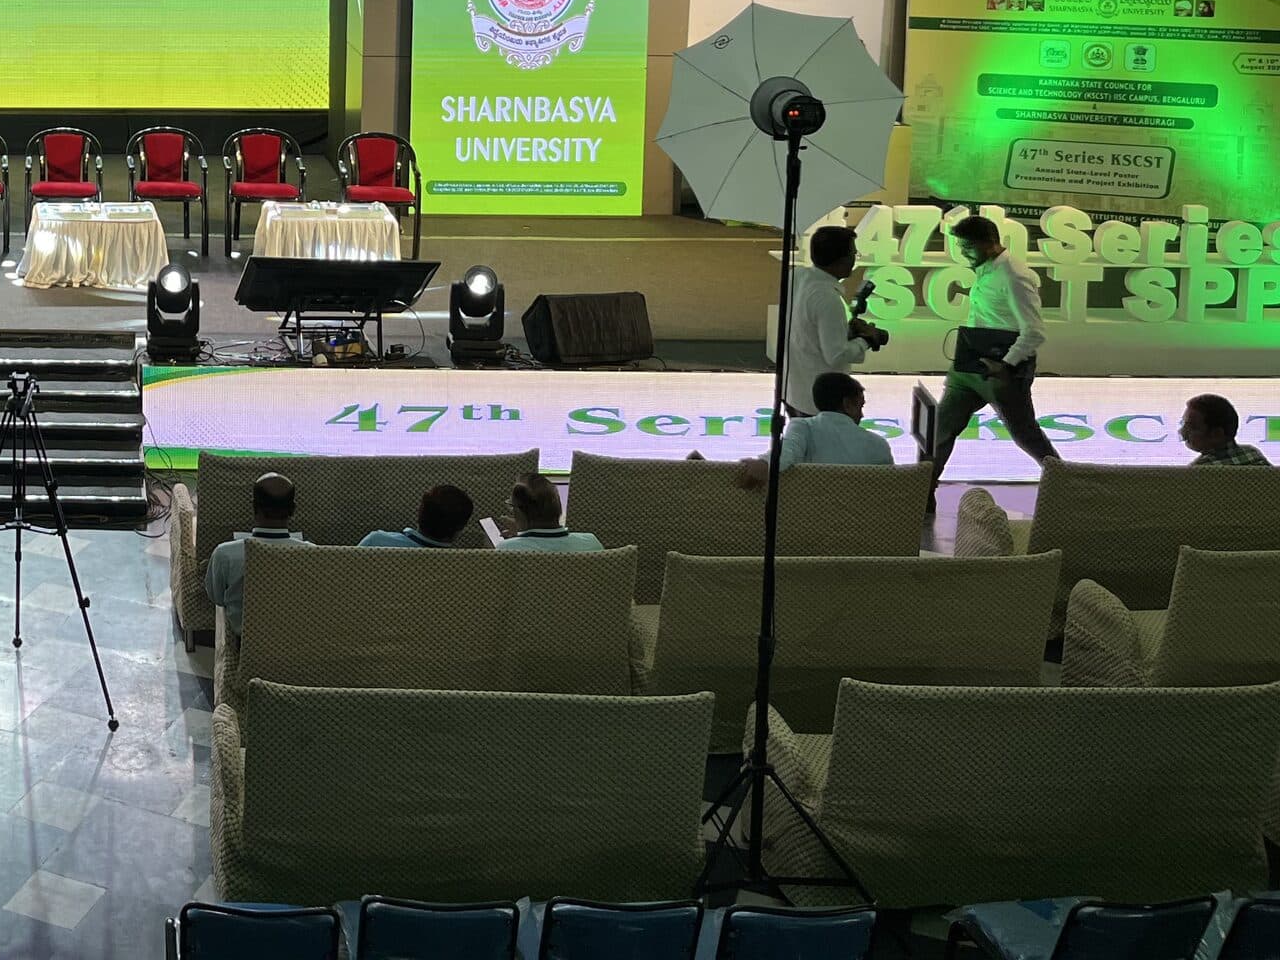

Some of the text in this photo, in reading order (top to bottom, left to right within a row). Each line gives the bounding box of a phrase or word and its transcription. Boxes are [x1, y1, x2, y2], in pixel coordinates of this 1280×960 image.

[1038, 78, 1152, 92] KARNATAKA STATE COUNCIL FOR
[988, 86, 1017, 96] SCIENCE
[1018, 87, 1033, 96] AND
[1034, 88, 1083, 99] TECHNOLOGY
[1162, 96, 1206, 105] BENGALURU
[440, 95, 617, 123] SHARNBASVA
[1015, 110, 1068, 120] SHARNBASVA
[1122, 115, 1176, 127] KALABURAGI
[455, 137, 603, 163] UNIVERSITY
[1018, 148, 1165, 169] 47th Series KSCST
[1015, 173, 1066, 184] Presentation
[1086, 179, 1115, 188] Project
[1117, 181, 1160, 190] Exhibition
[324, 402, 1280, 444] 47th Seris KSCT
